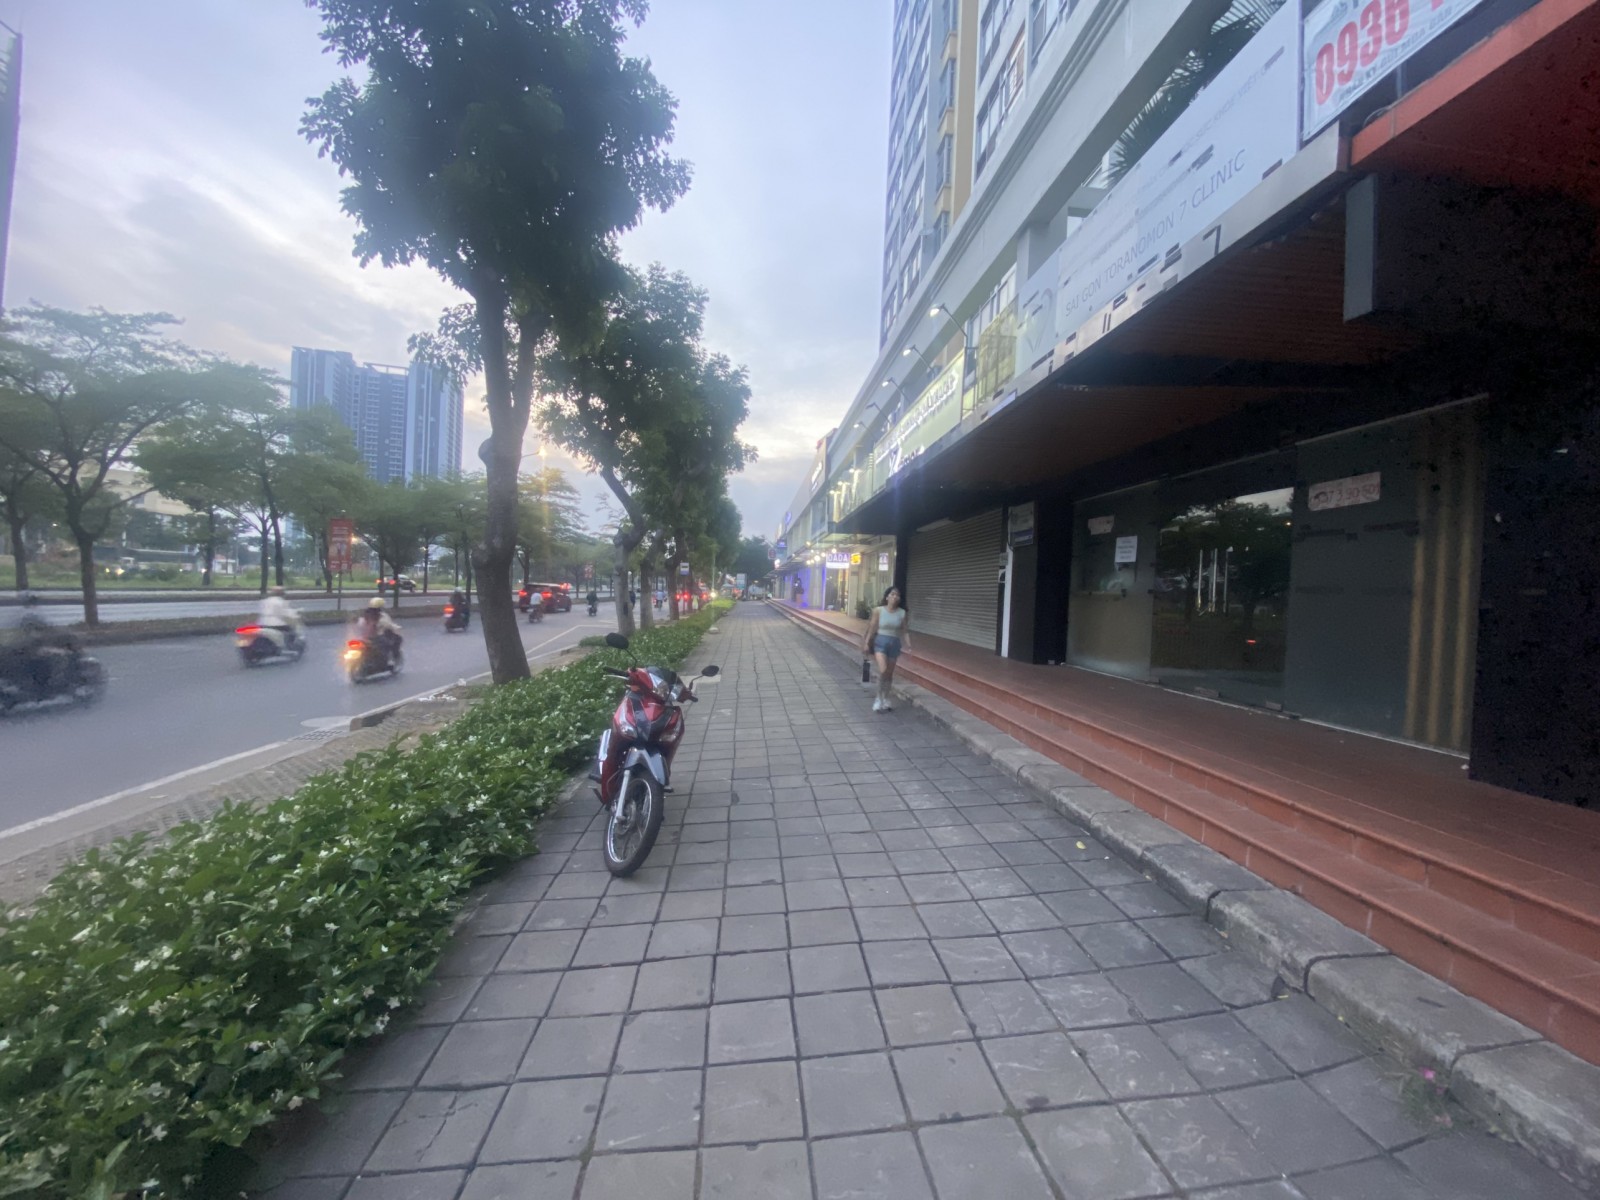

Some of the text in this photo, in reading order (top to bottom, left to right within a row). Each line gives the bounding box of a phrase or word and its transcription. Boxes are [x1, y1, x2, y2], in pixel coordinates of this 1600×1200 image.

[1065, 149, 1245, 317] SAI GON TORANOMON 7 CLINIC
